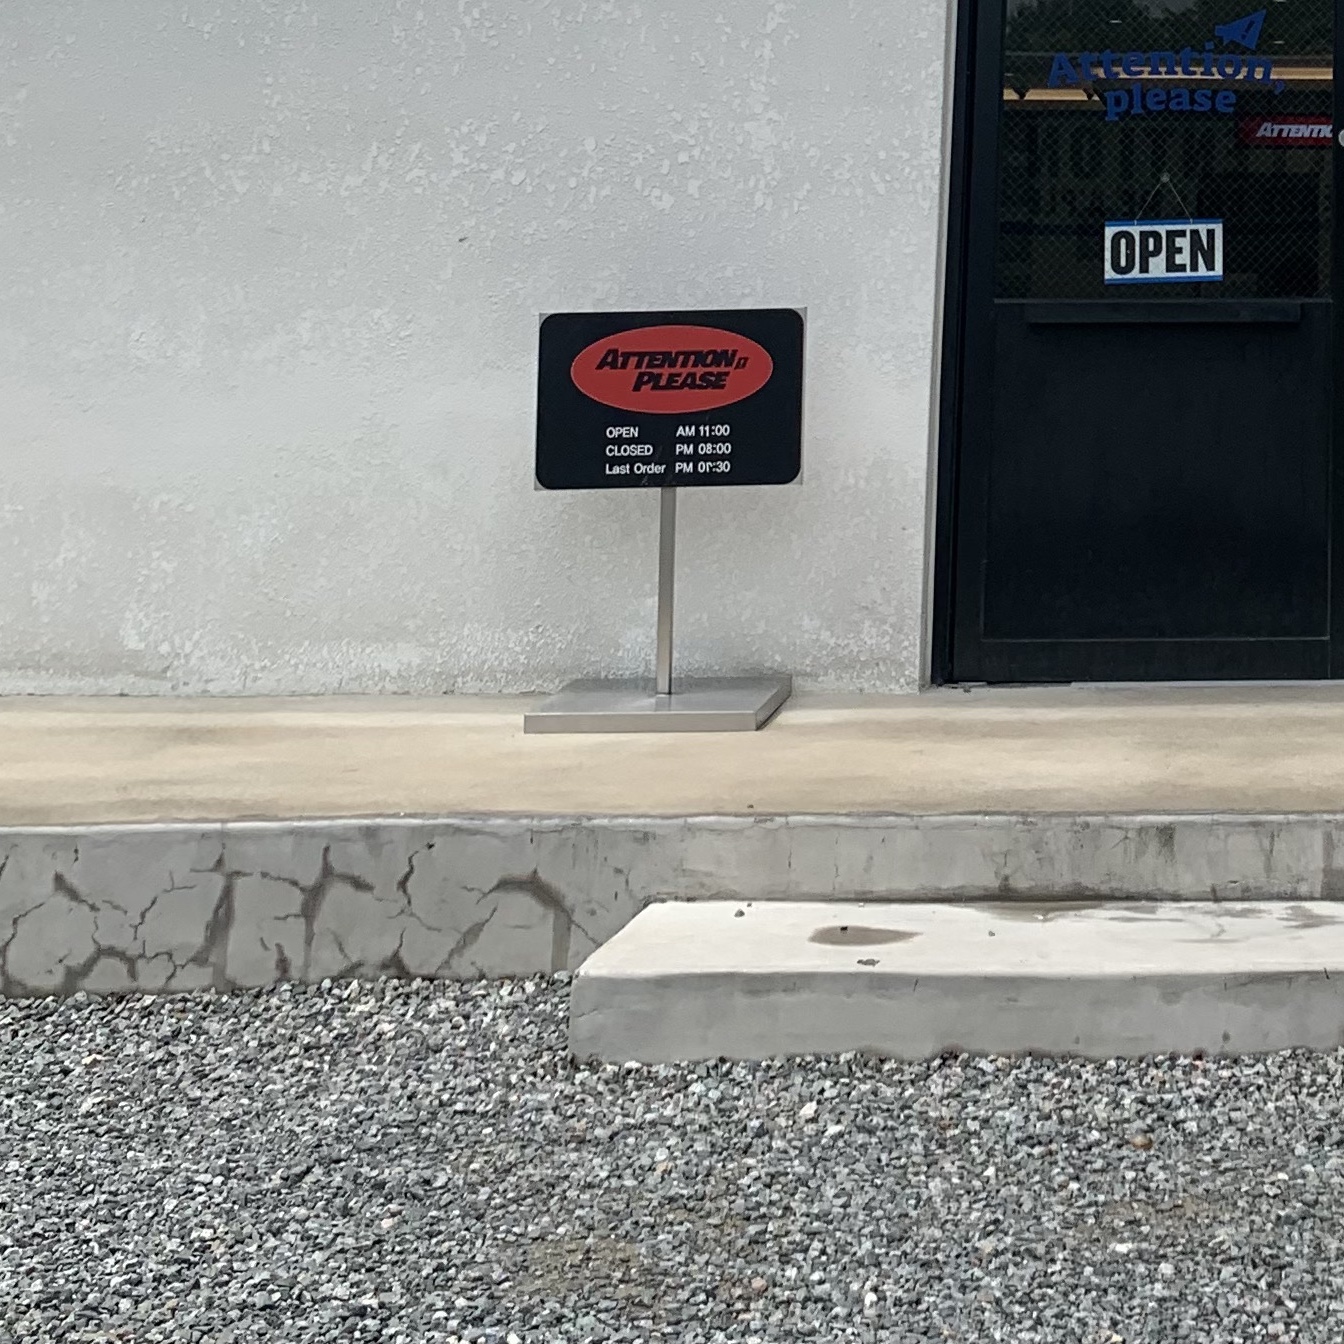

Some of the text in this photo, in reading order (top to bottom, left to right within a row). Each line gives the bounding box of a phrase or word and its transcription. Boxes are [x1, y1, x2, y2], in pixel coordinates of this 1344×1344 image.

[1047, 41, 1286, 95] Attention,
[1104, 82, 1237, 122] please
[1109, 227, 1216, 276] OPEN
[632, 371, 731, 392] PLEASE
[605, 424, 731, 438] OPEN AM 11:00
[605, 442, 732, 457] CLOSED PM 08:00
[605, 462, 631, 475] Last
[633, 461, 667, 474] Order
[675, 461, 694, 473] PM
